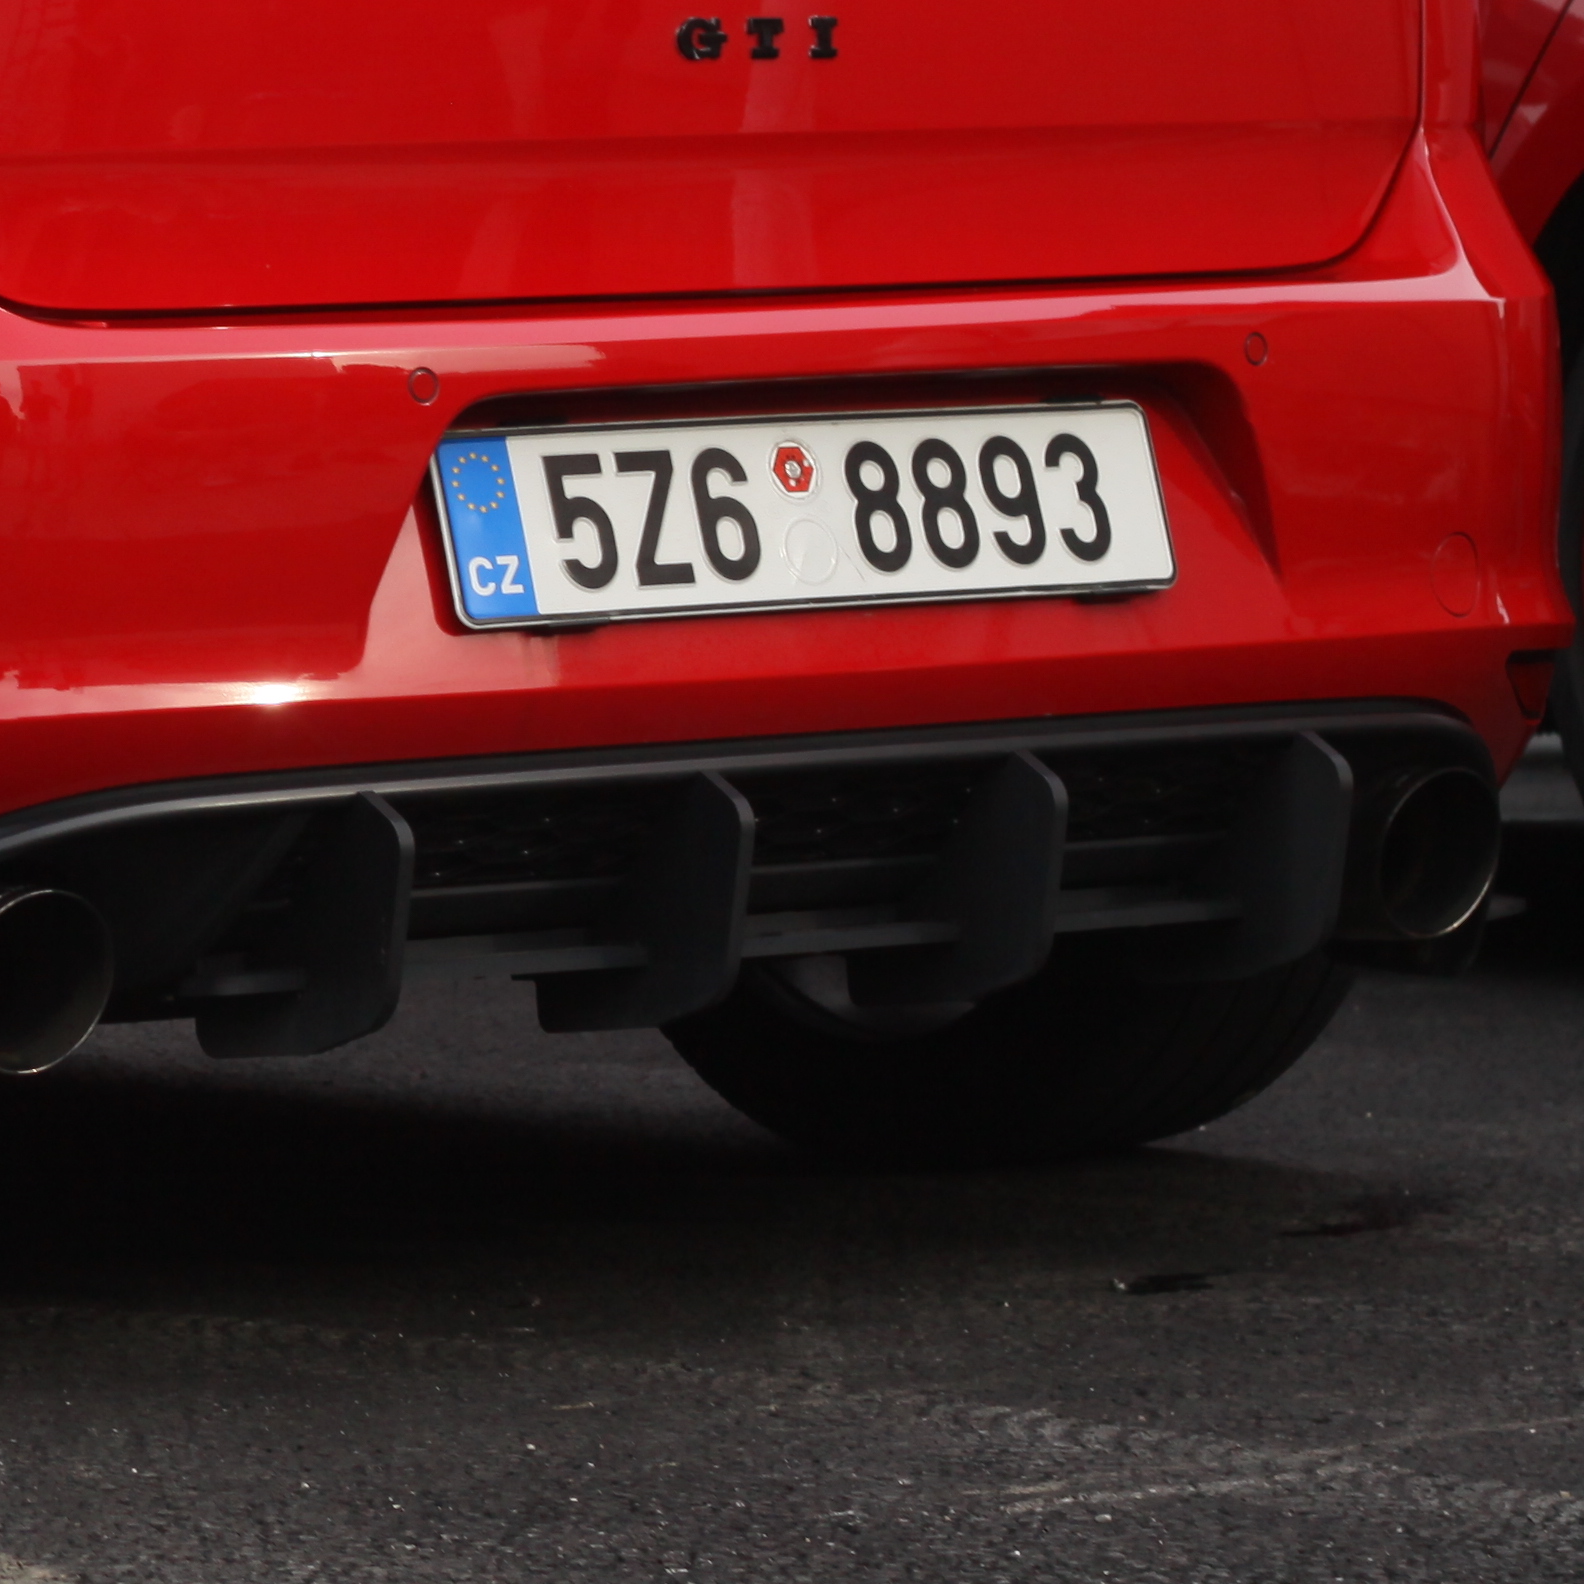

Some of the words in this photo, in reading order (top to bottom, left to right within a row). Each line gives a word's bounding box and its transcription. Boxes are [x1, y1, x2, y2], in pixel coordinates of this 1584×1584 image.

[676, 15, 839, 61] GTI
[542, 447, 763, 591] 5Z6
[843, 432, 1113, 574] 8893
[468, 554, 525, 598] CZ
